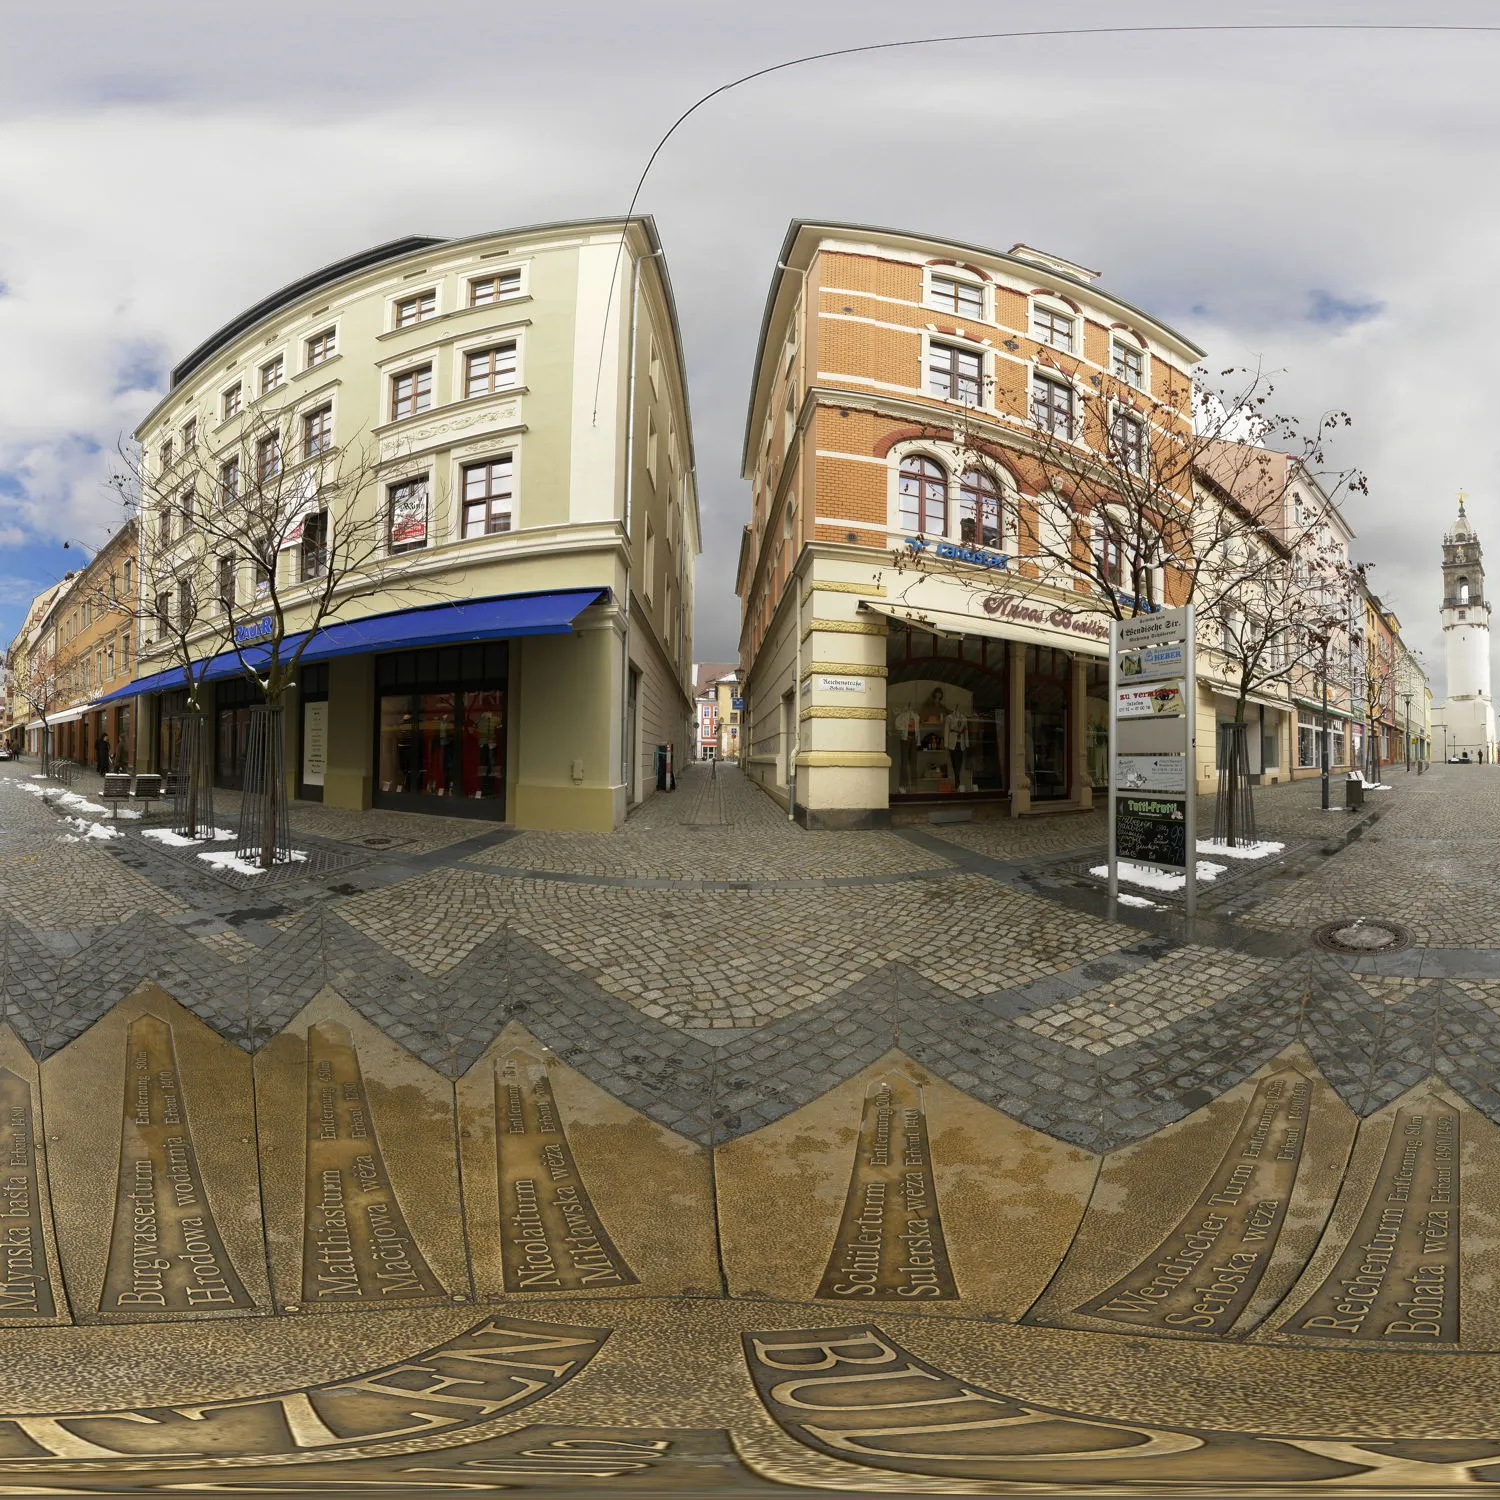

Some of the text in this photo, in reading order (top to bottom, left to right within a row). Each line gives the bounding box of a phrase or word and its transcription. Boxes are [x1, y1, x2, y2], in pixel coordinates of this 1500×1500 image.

[936, 543, 1009, 569] randstad
[983, 595, 1111, 640] Annas Boutiqu
[1125, 623, 1163, 637] Wendische
[1154, 650, 1182, 661] HEBER
[135, 1075, 151, 1126] Entfernung
[165, 1092, 180, 1125] Erbaut
[320, 1088, 337, 1140] Entfernung
[351, 1108, 367, 1138] Erbaut
[508, 1084, 525, 1134] Entfernung
[537, 1101, 556, 1133] Erbaut
[10, 1131, 28, 1166] Erbaut
[870, 1108, 893, 1166] Entfernung
[905, 1129, 923, 1166] Erbaut
[1242, 1102, 1281, 1158] Entfernung
[1276, 1128, 1300, 1161] Erbaut
[1388, 1115, 1423, 1203] Entfernung 80m
[1430, 1166, 1451, 1204] Erbaut
[117, 1160, 171, 1307] Burgwasserturm
[162, 1136, 235, 1306] Hrodowa wodarnja
[317, 1169, 362, 1296] Matthiasturm
[511, 1179, 561, 1288] Nicolaiturm
[833, 1182, 886, 1296] Schülerturm
[1097, 1164, 1254, 1314] Wendischer Turm
[1164, 1252, 1259, 1328] Serbska
[1302, 1207, 1405, 1333] Reichenturm
[1384, 1264, 1446, 1337] Bohata
